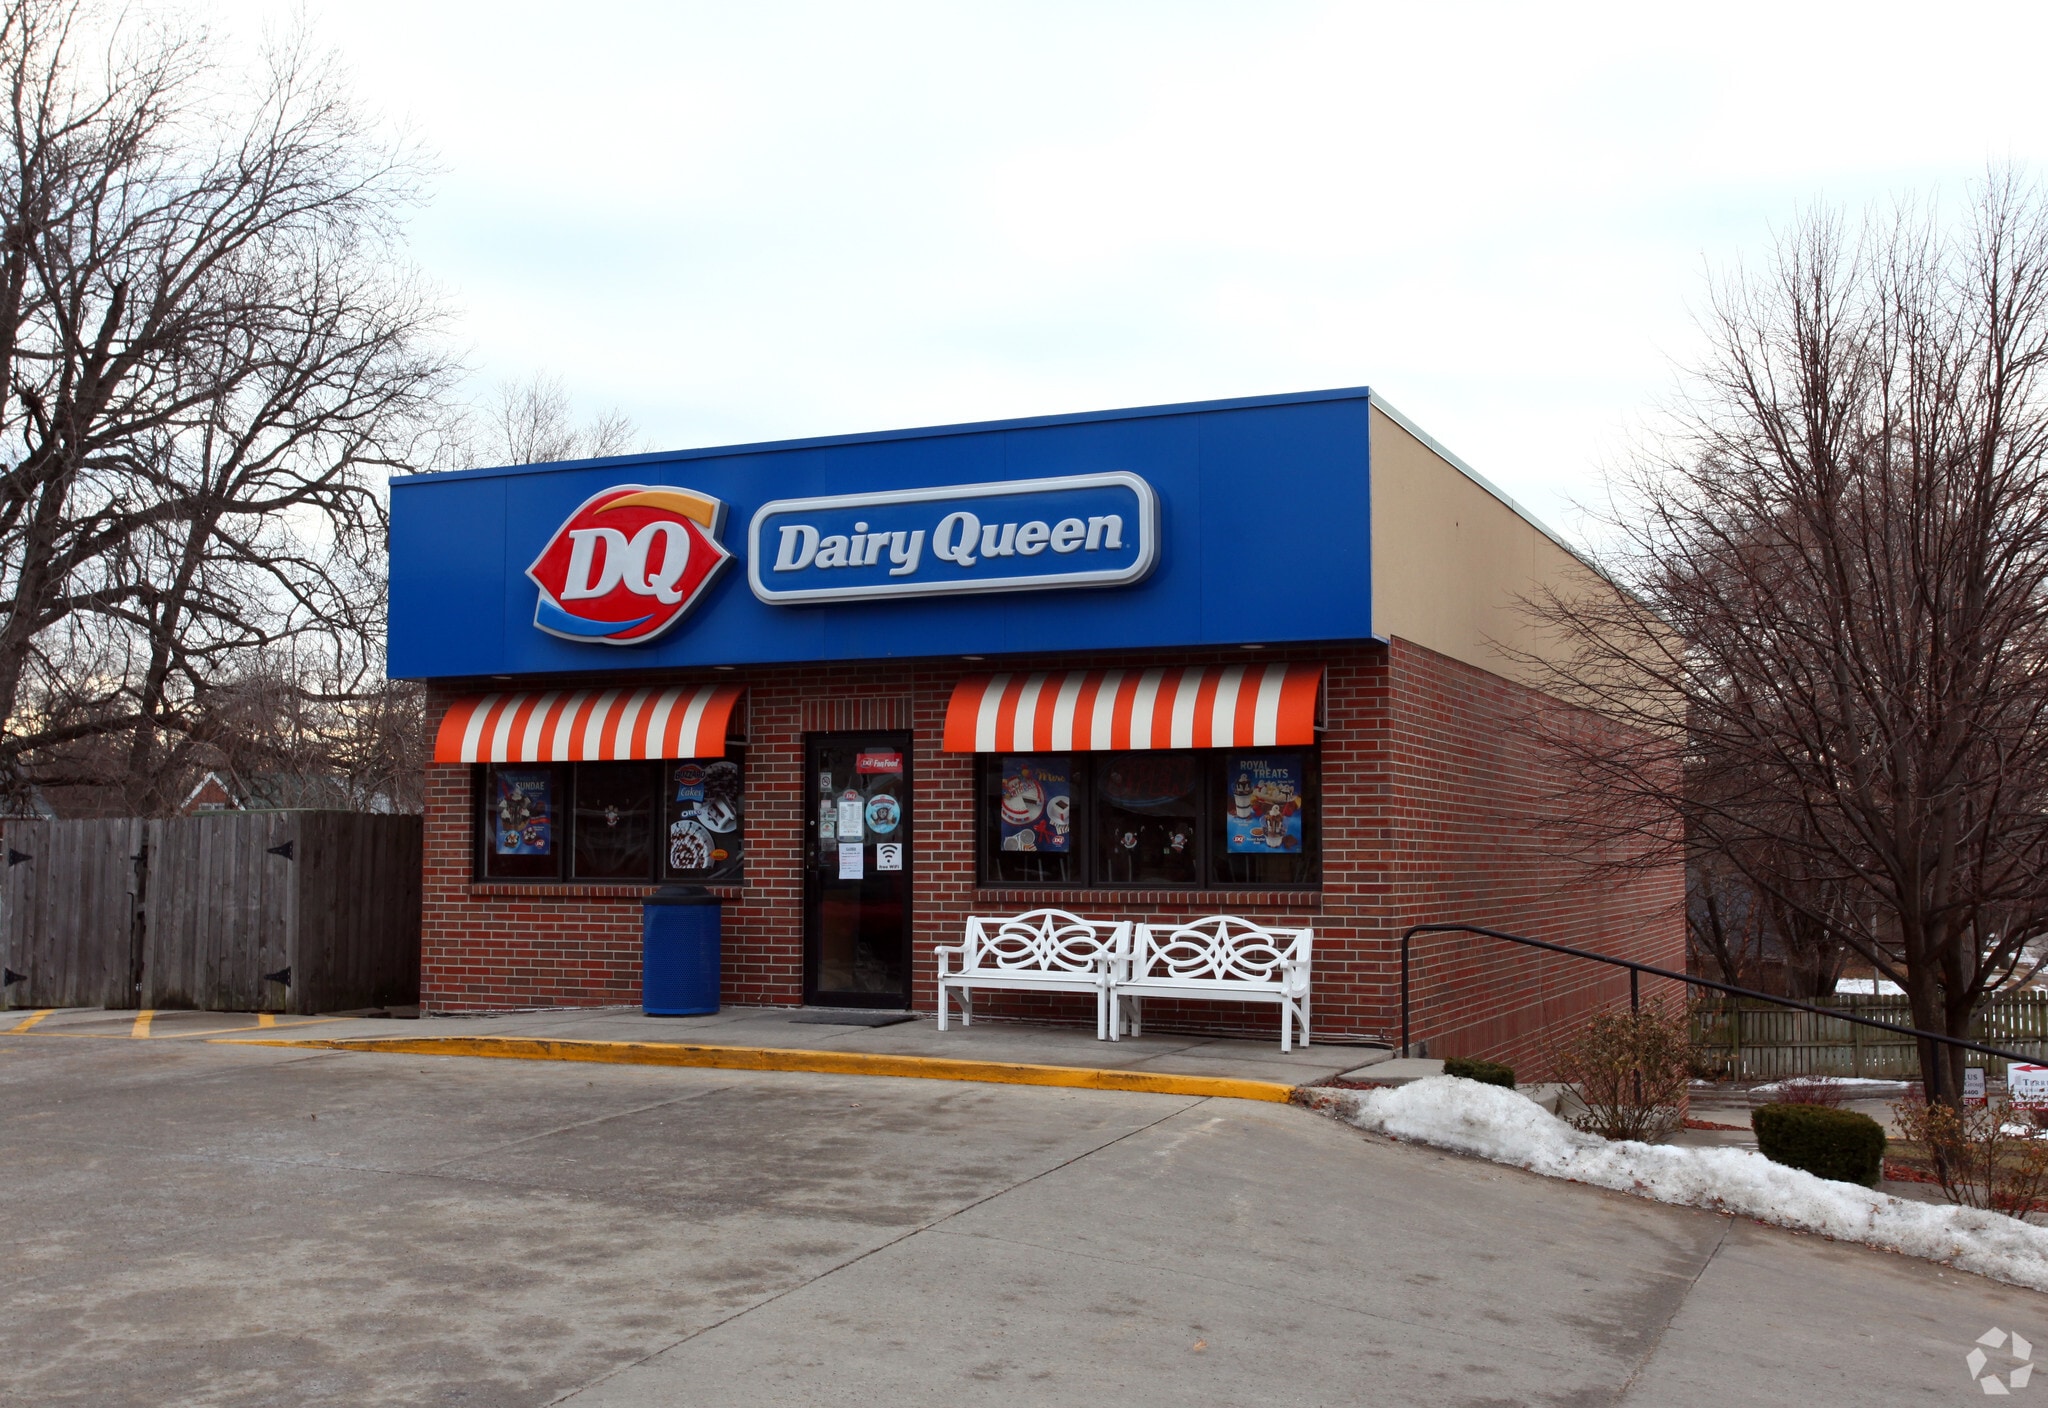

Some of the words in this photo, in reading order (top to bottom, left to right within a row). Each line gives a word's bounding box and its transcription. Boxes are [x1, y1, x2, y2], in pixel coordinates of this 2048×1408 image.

[773, 521, 926, 577] Dairy
[932, 511, 1124, 568] Queen
[560, 520, 691, 605] DQ
[1240, 760, 1268, 770] ROYAL
[1253, 768, 1289, 779] TREATS
[516, 781, 545, 791] SUNDAE
[680, 787, 702, 797] Cakes
